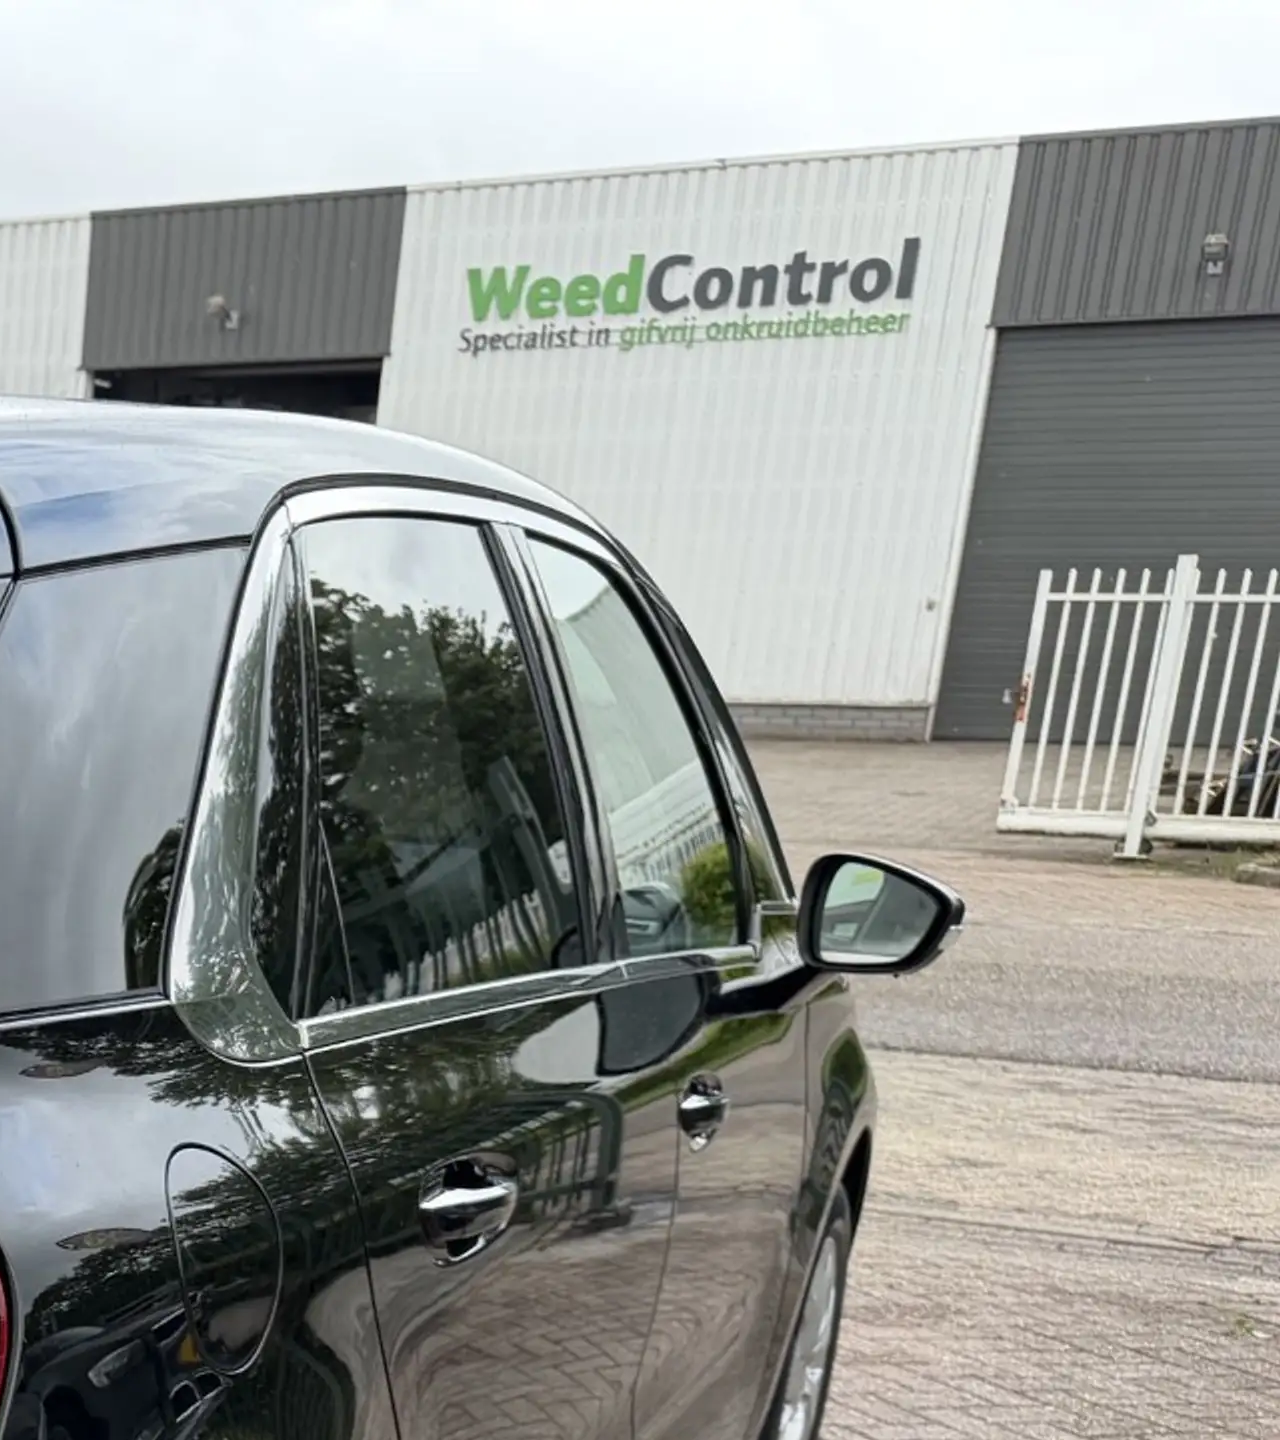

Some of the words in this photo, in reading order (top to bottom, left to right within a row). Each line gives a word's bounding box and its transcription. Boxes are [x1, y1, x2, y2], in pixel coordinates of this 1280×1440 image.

[467, 237, 921, 322] WeedControl
[458, 322, 577, 359] Specialist
[588, 321, 611, 347] in
[619, 315, 698, 352] gifvrij
[705, 308, 911, 342] onkruidbeheer
